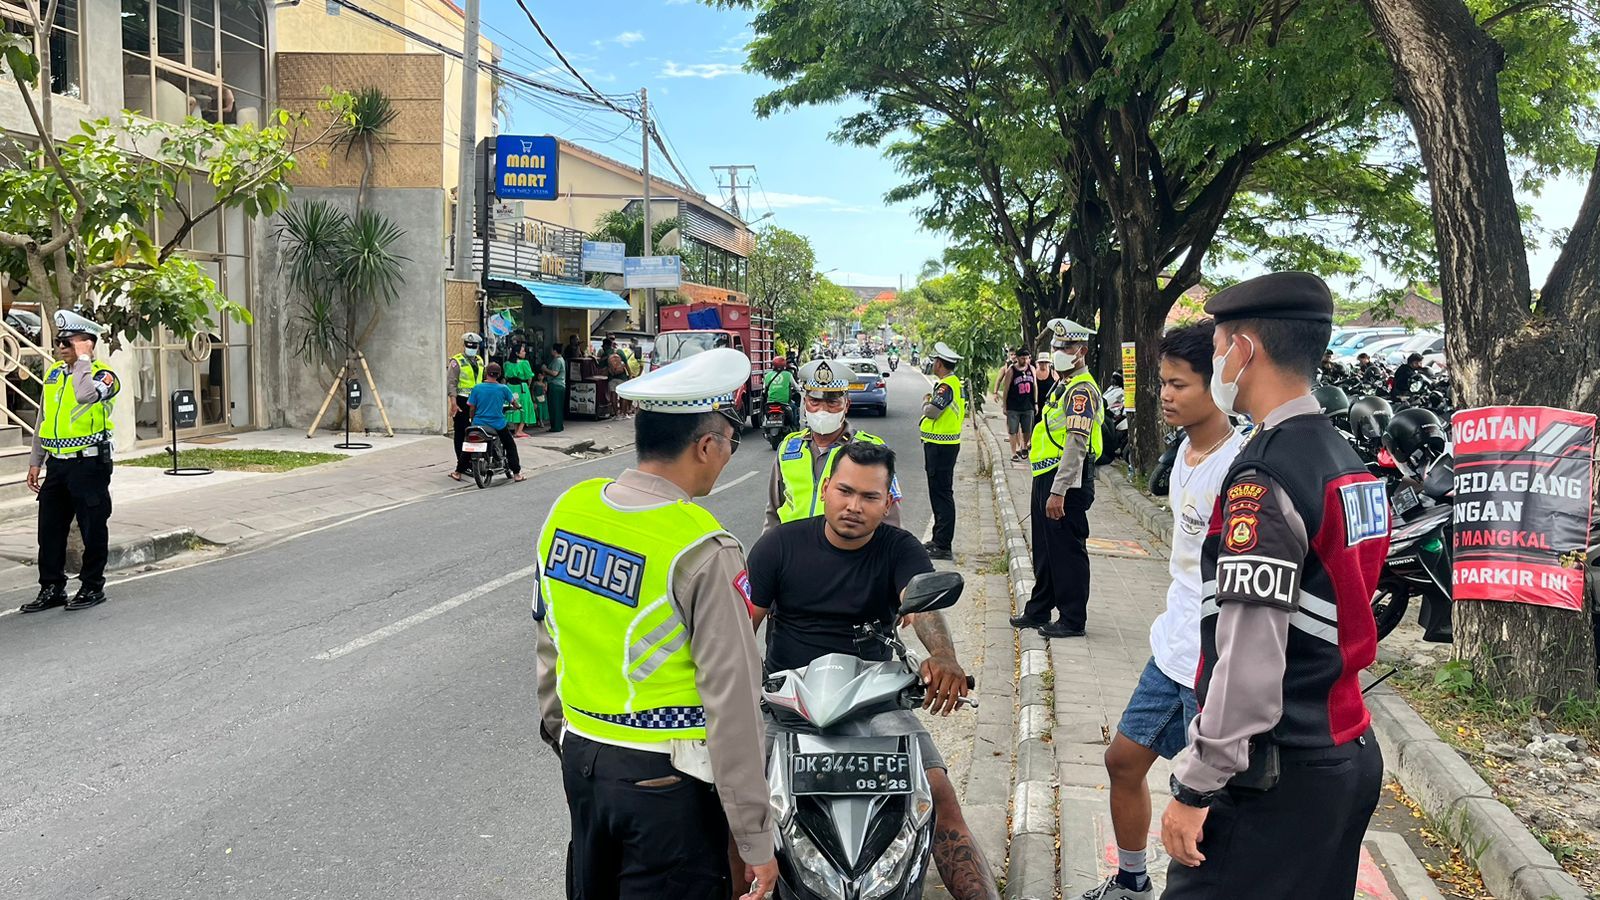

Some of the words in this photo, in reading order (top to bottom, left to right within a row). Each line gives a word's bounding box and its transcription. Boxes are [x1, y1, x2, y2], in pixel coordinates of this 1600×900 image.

[506, 154, 545, 169] MANI
[504, 173, 547, 187] MART
[1453, 471, 1582, 499] PEDAGANG
[1462, 529, 1549, 549] MANGKAL
[548, 538, 639, 598] POLISI
[1388, 558, 1415, 566] HONDA
[1216, 562, 1296, 603] TROLI
[1461, 567, 1533, 586] PARKIR
[1541, 573, 1569, 591] INI
[795, 756, 817, 773] DK
[821, 755, 868, 773] 3445
